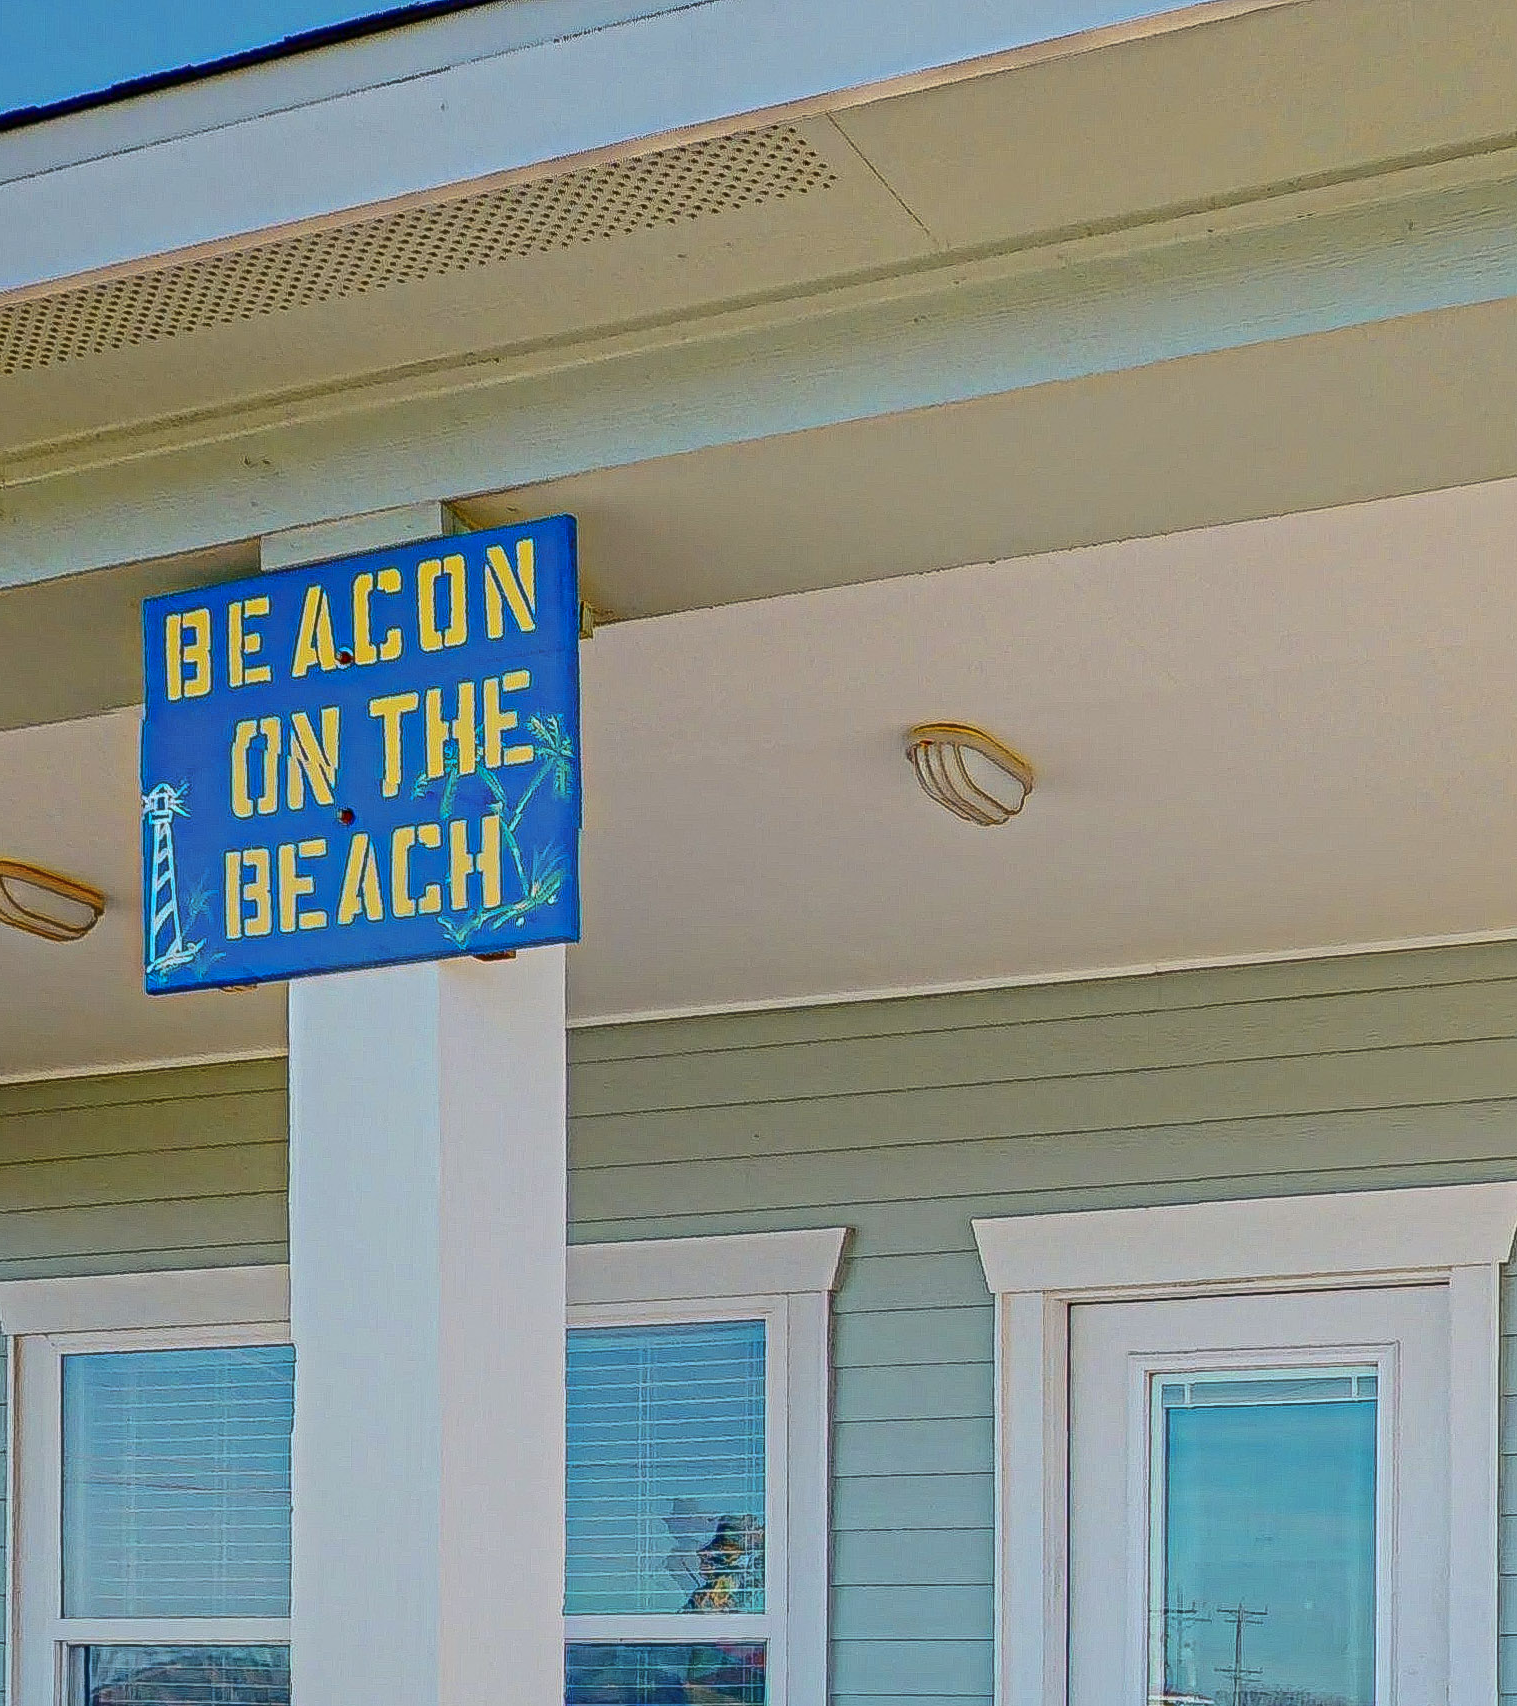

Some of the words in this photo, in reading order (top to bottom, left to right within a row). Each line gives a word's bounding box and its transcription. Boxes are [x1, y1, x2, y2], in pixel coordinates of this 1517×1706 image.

[165, 538, 536, 701] BEACON
[229, 706, 340, 818] ON
[368, 669, 534, 798] THE
[224, 814, 503, 940] BEACH
